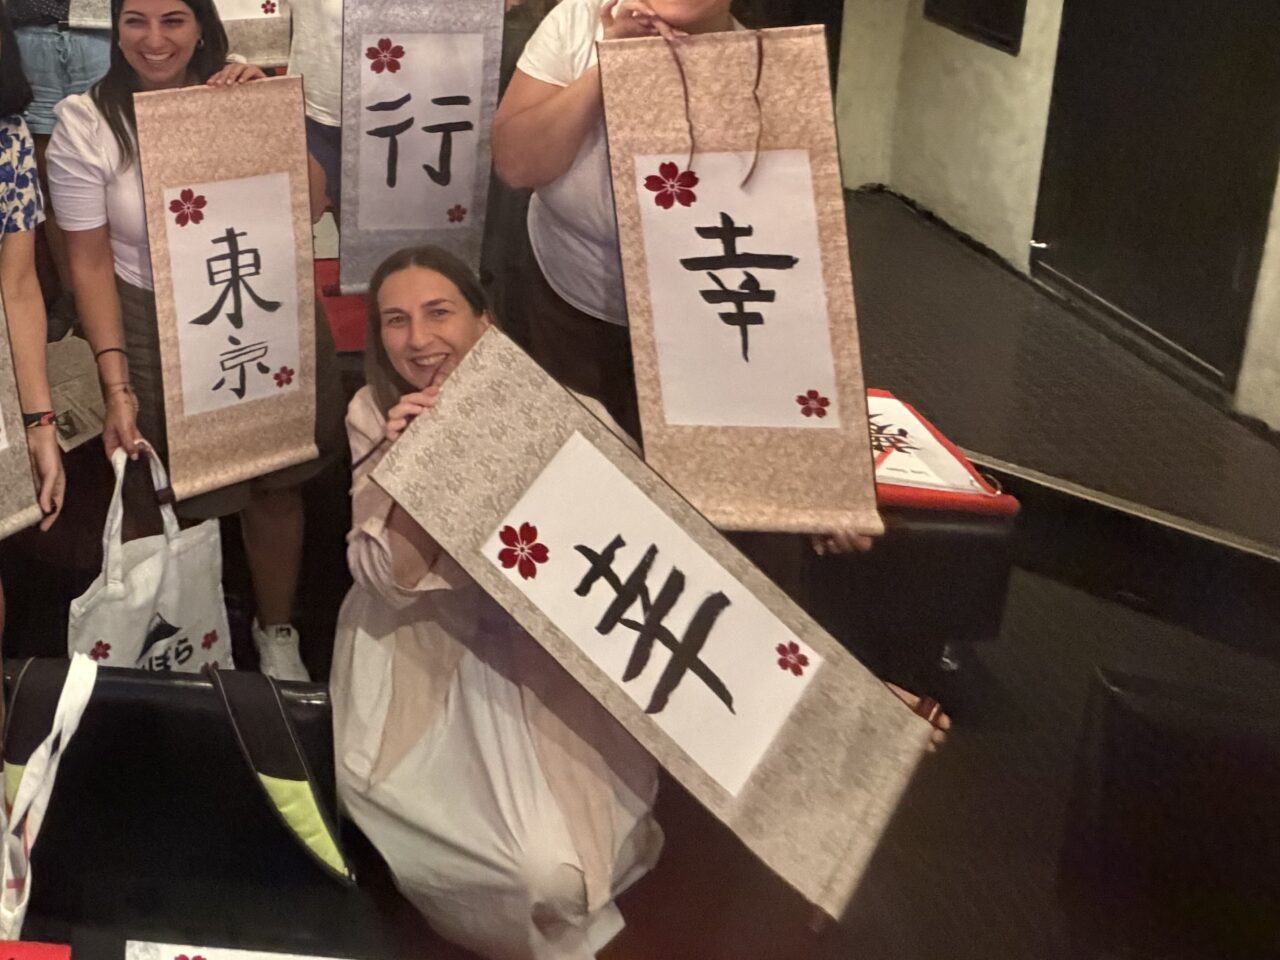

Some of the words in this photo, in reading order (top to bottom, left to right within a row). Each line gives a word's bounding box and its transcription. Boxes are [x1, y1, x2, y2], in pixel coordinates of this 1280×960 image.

[365, 92, 475, 189] 行
[188, 227, 283, 400] 東京
[679, 212, 799, 364] 幸
